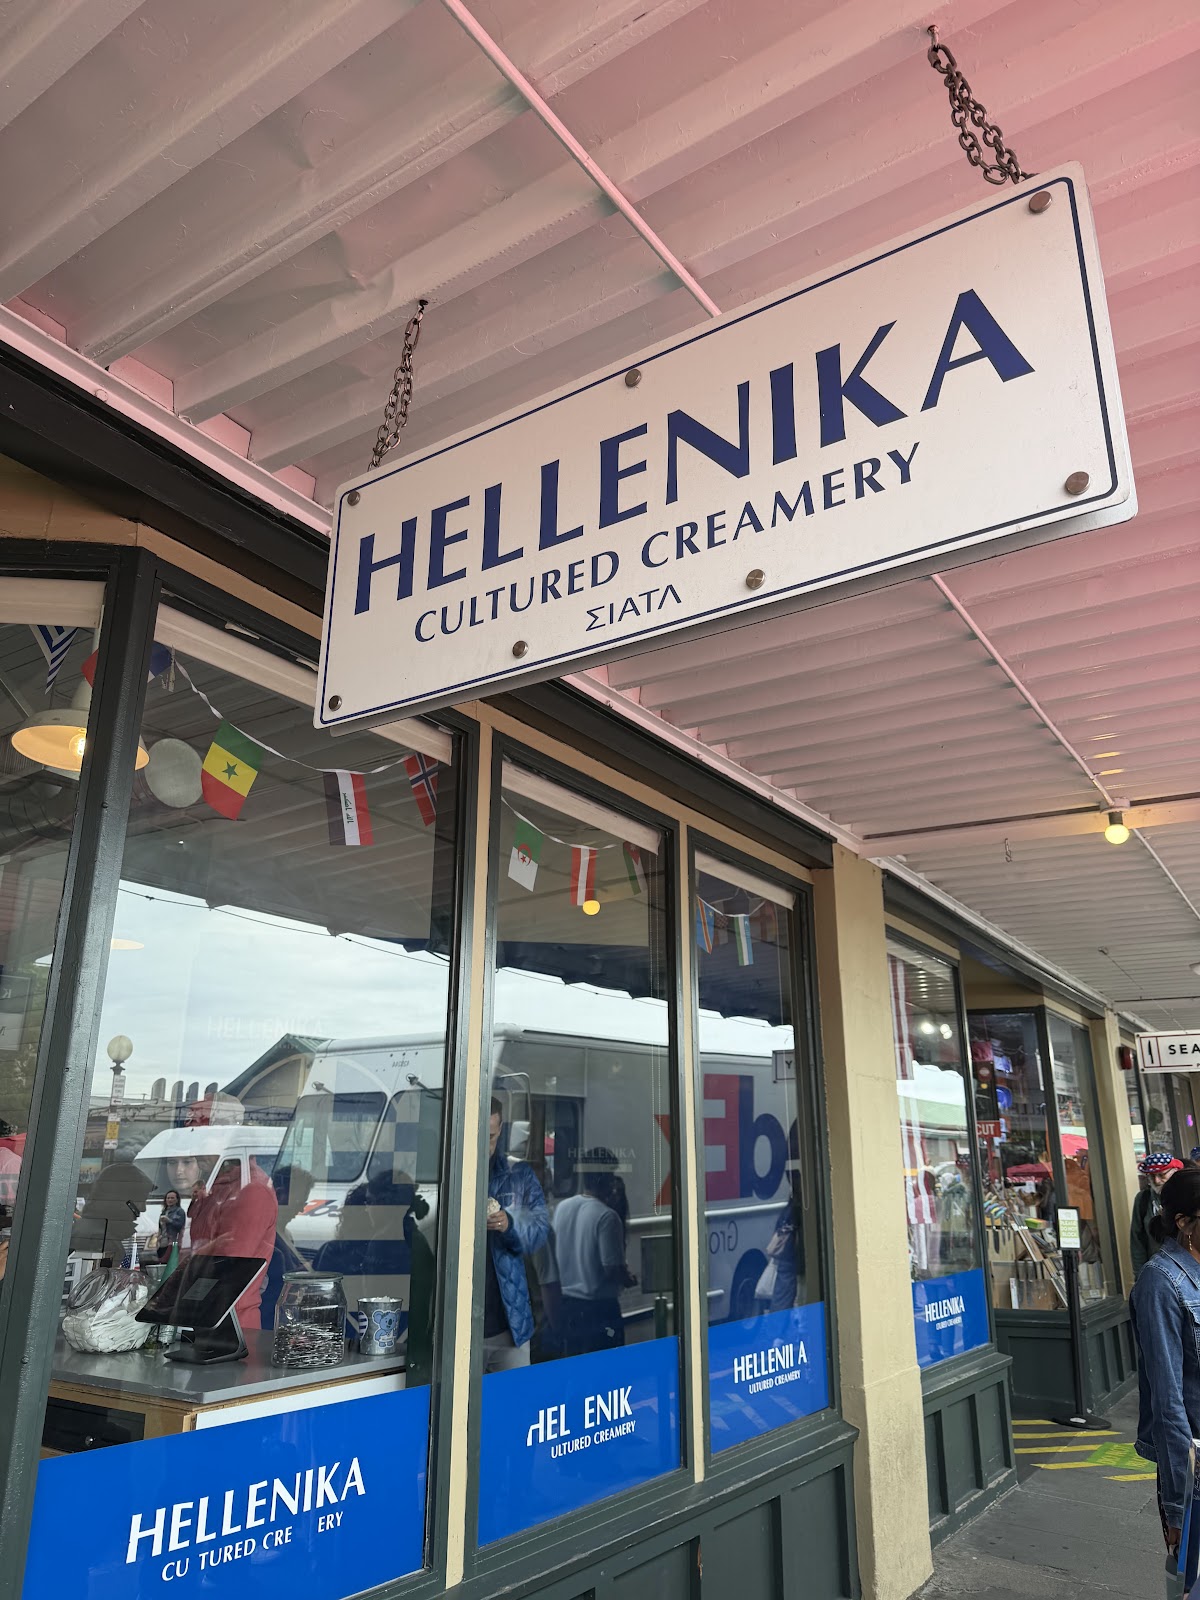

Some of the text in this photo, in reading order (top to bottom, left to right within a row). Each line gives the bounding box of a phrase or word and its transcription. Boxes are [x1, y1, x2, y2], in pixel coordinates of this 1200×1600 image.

[355, 289, 1035, 616] HELLENIKA
[414, 443, 919, 643] CULTURED CREAMERY
[593, 1420, 636, 1445] CREAMERY
[125, 1457, 366, 1564] HELLENIKA
